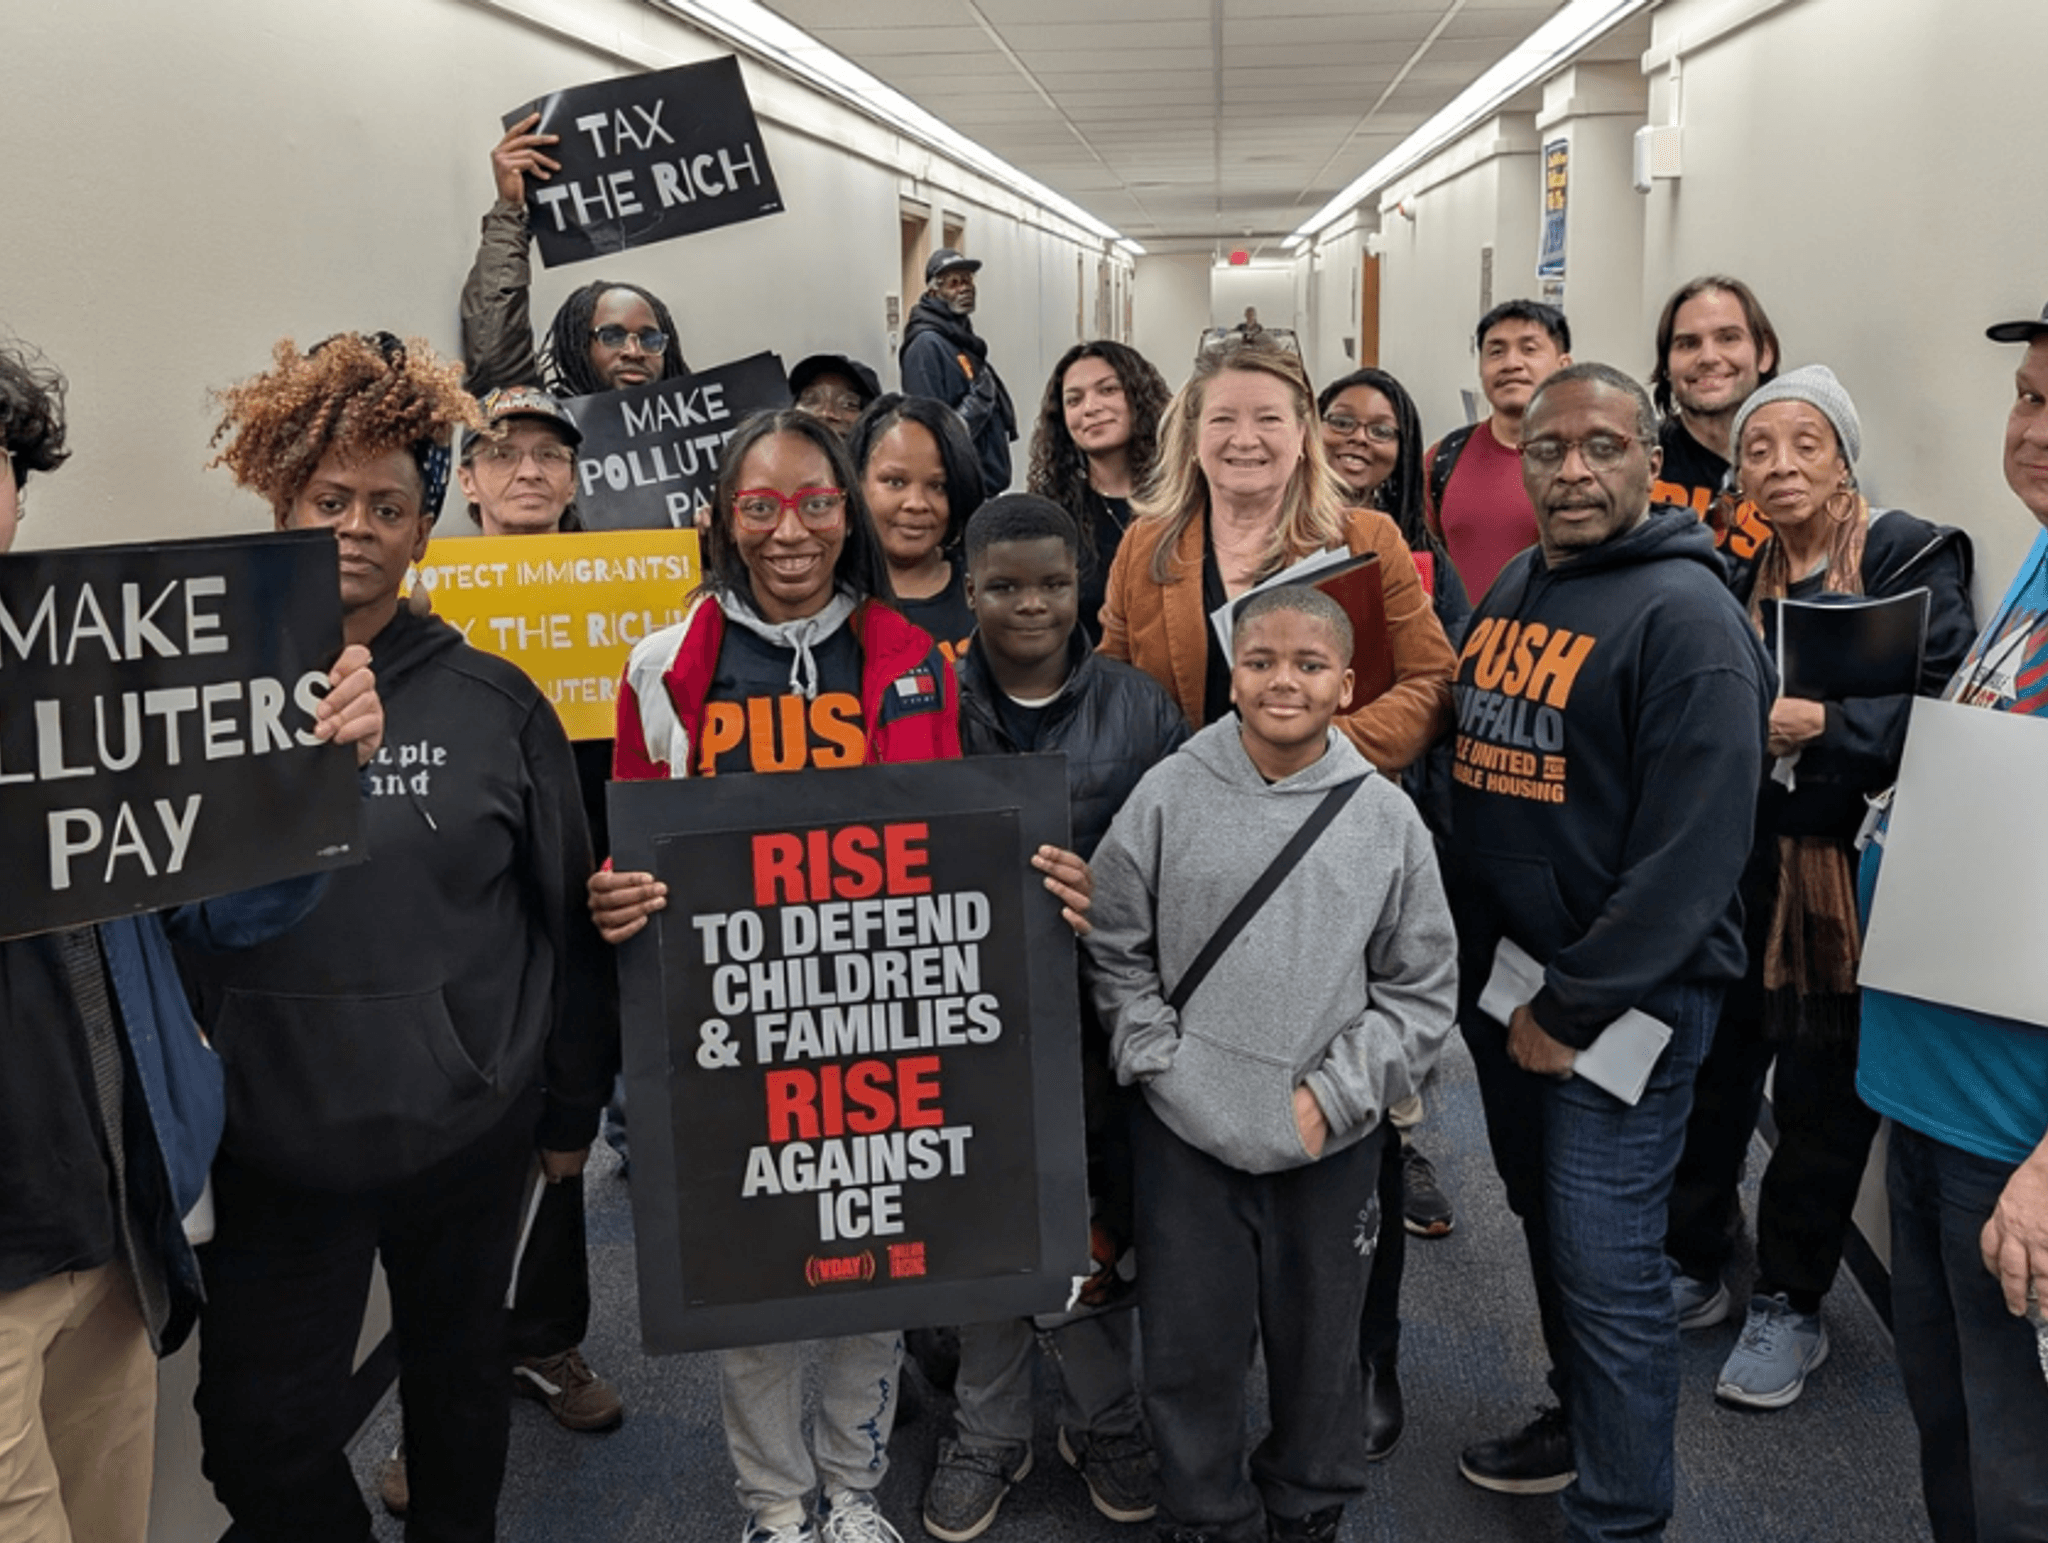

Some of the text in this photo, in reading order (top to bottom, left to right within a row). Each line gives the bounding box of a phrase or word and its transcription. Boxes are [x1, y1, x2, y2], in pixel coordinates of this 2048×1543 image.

[576, 99, 675, 158] TAX
[536, 143, 760, 231] THE RICH
[620, 383, 731, 437] MAKE
[517, 556, 690, 584] IMMIGRANTS!
[0, 577, 229, 665] MAKE
[490, 614, 573, 650] THE
[1453, 616, 1596, 709] PUSH
[0, 671, 333, 783] LUTERS
[698, 692, 867, 777] PUS
[1469, 741, 1537, 776] UNITED
[1486, 772, 1565, 803] HOUSING
[48, 795, 202, 890] PAY
[751, 822, 931, 907] RISE
[692, 891, 991, 964] TO DEFEND
[713, 943, 980, 1016] CHILDREN
[696, 993, 1002, 1069] & FAMILIES
[765, 1055, 944, 1142] RISE
[741, 1125, 973, 1197] AGAINST
[819, 1184, 904, 1241] ICE
